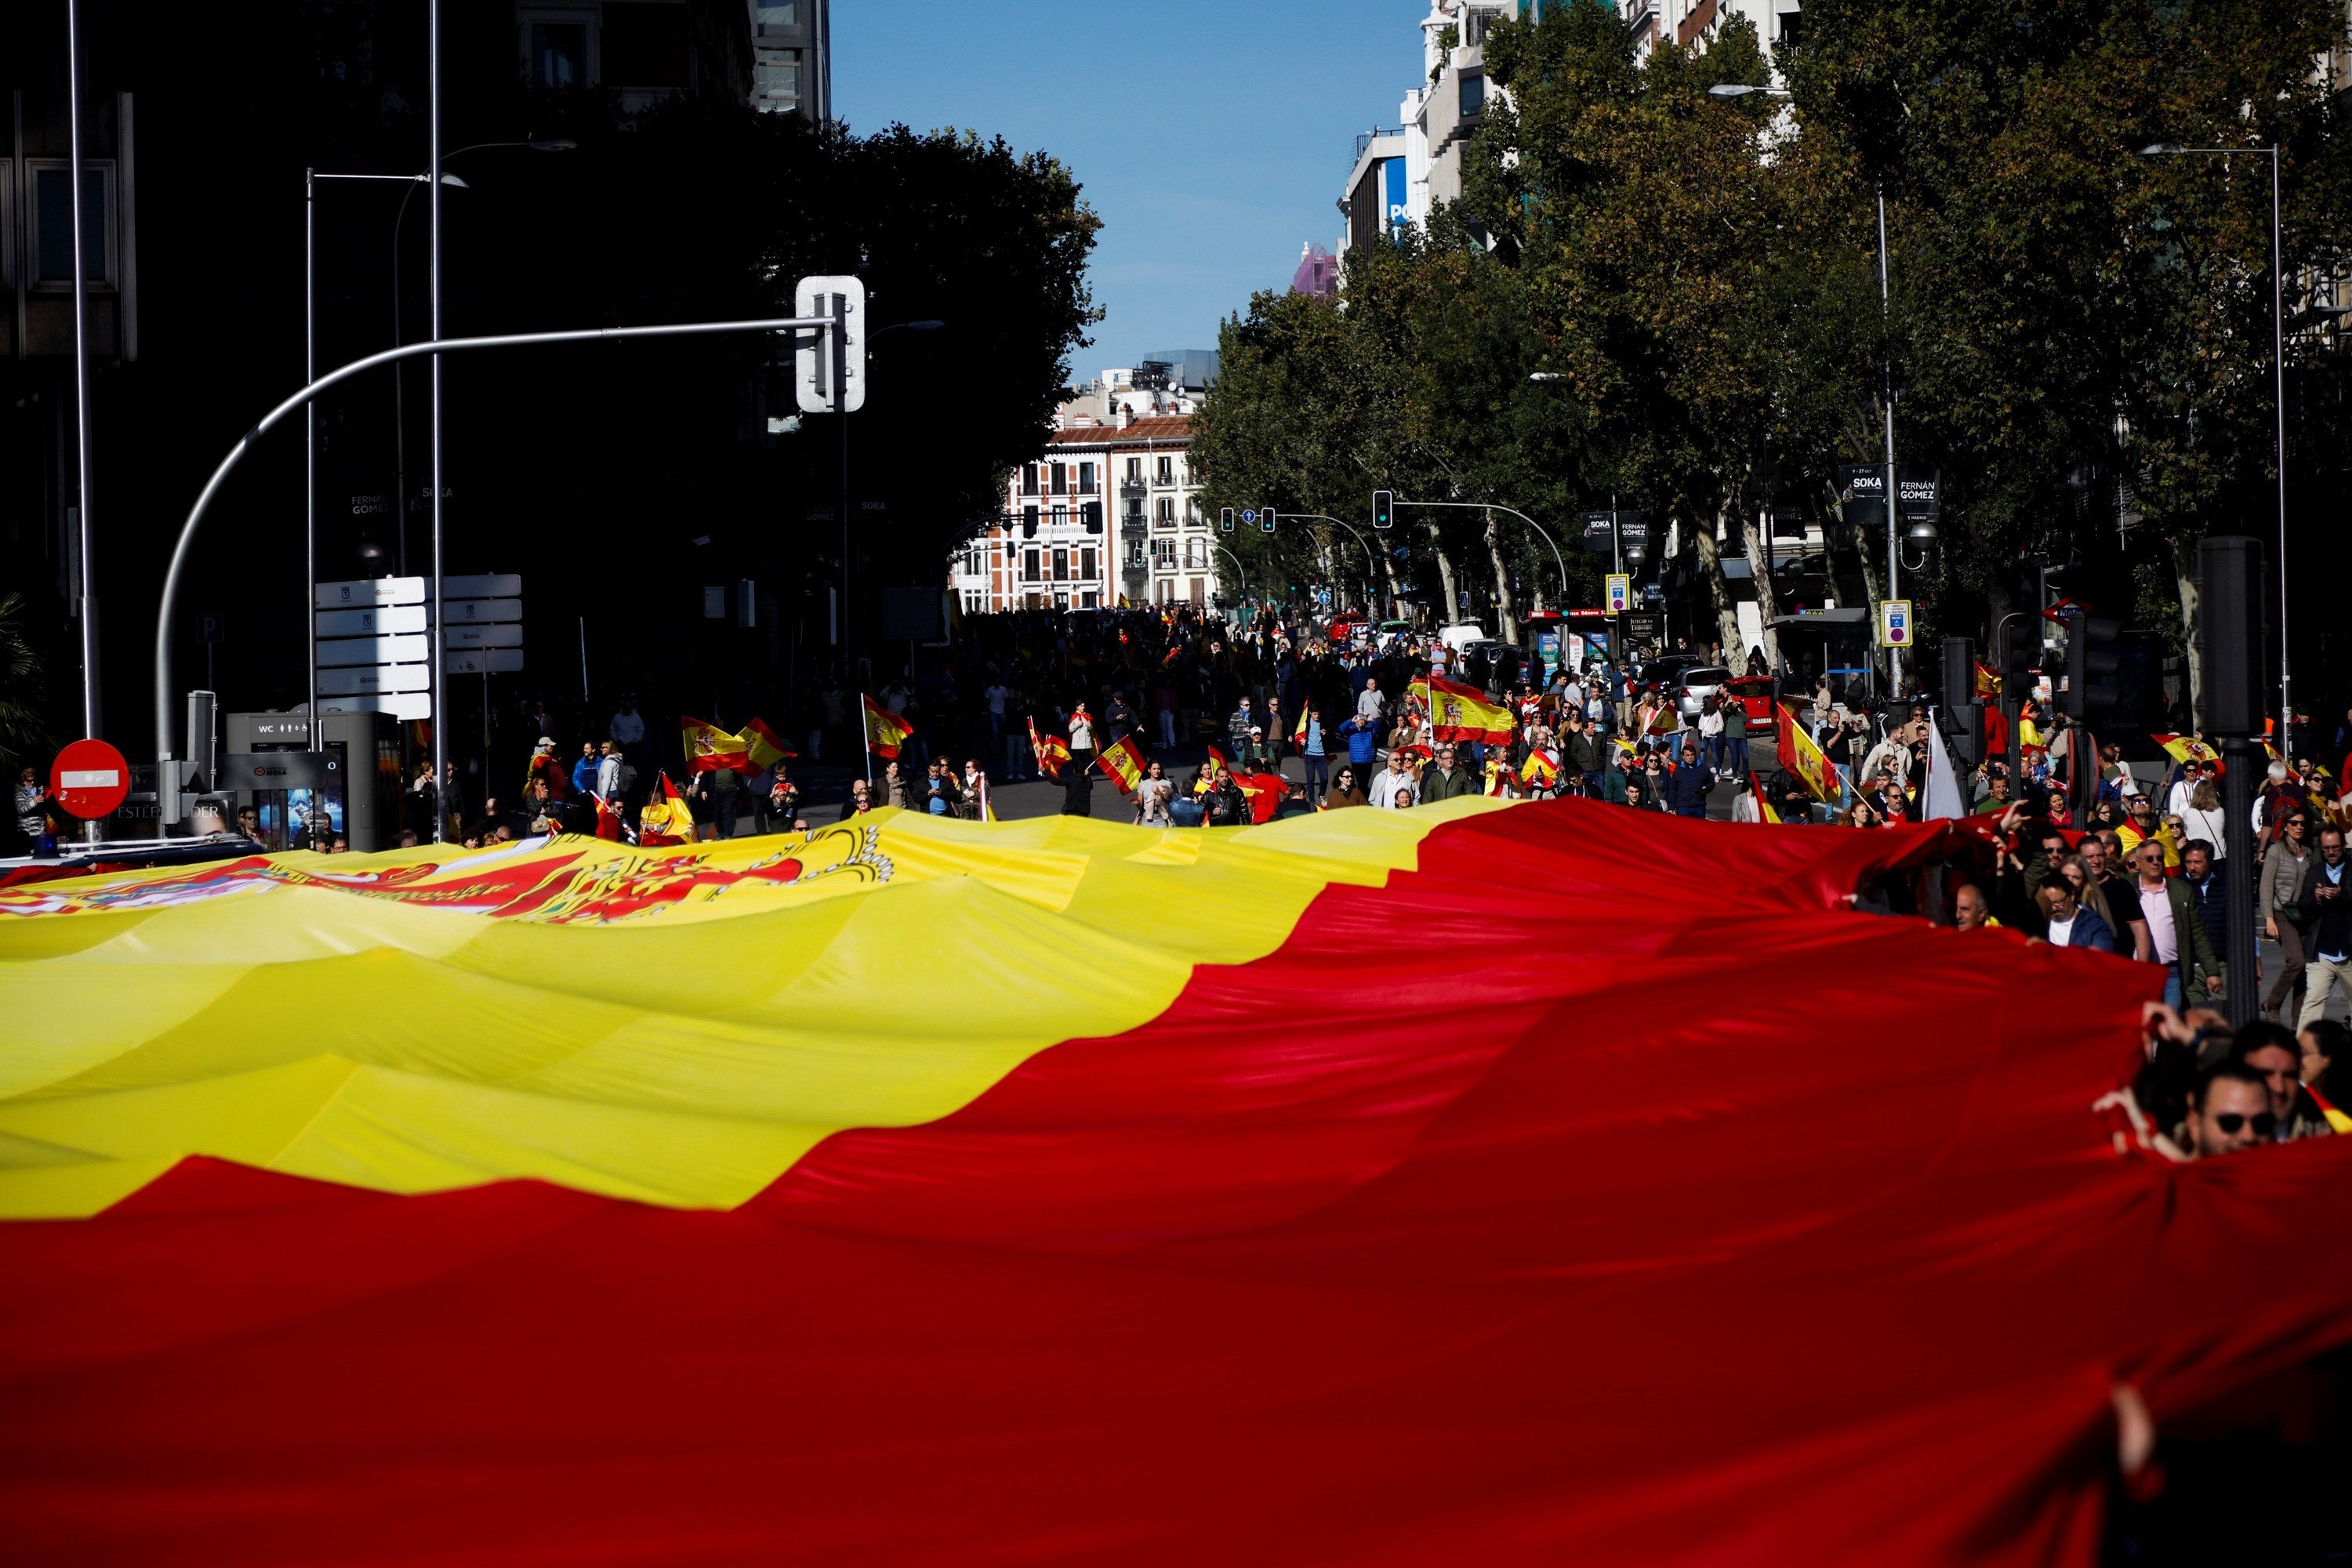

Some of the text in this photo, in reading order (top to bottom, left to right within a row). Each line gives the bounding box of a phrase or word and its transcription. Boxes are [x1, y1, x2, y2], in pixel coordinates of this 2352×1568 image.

[1853, 477, 1882, 488] SOKA
[1900, 481, 1935, 490] FERNÁN
[1900, 490, 1934, 499] GÓMEZ
[204, 617, 216, 639] P
